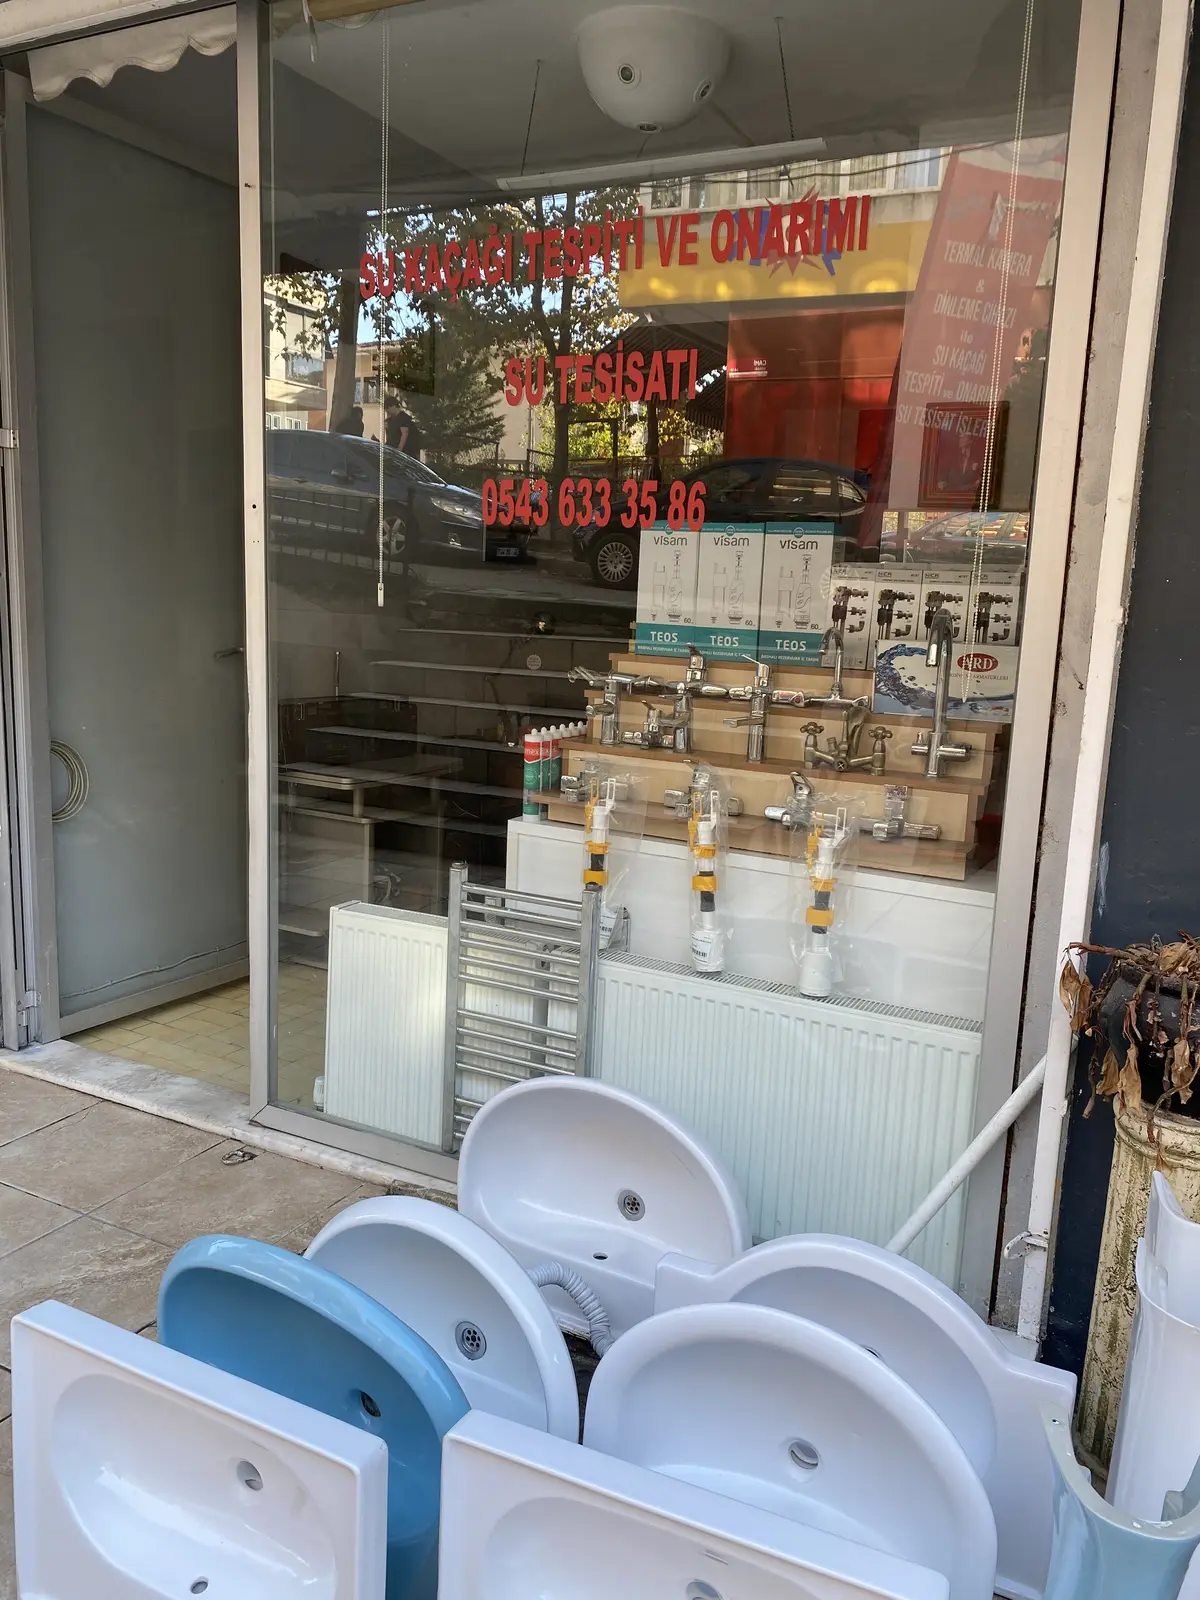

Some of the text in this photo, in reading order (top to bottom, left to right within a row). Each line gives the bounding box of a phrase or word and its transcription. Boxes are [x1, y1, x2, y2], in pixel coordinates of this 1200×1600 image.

[359, 195, 871, 303] SU KAÇAĞI TESPİTİ VE ONARIMI
[944, 240, 985, 268] TERMAL
[975, 280, 984, 293] &
[934, 290, 982, 320] DİNLEME
[933, 345, 950, 366] SU
[505, 340, 699, 406] SU TESİSATI
[903, 370, 945, 397] TESPİTİ
[943, 389, 953, 399] ve
[896, 404, 913, 424] SU
[914, 407, 956, 431] TESİSAT
[482, 478, 708, 531] 0543 633 35 86
[653, 536, 688, 546] visam
[713, 535, 750, 547] visam
[779, 538, 819, 550] visam
[650, 631, 678, 643] TEOS
[710, 635, 739, 647] TEOS
[775, 639, 807, 651] TEOS
[963, 656, 993, 669] ARD
